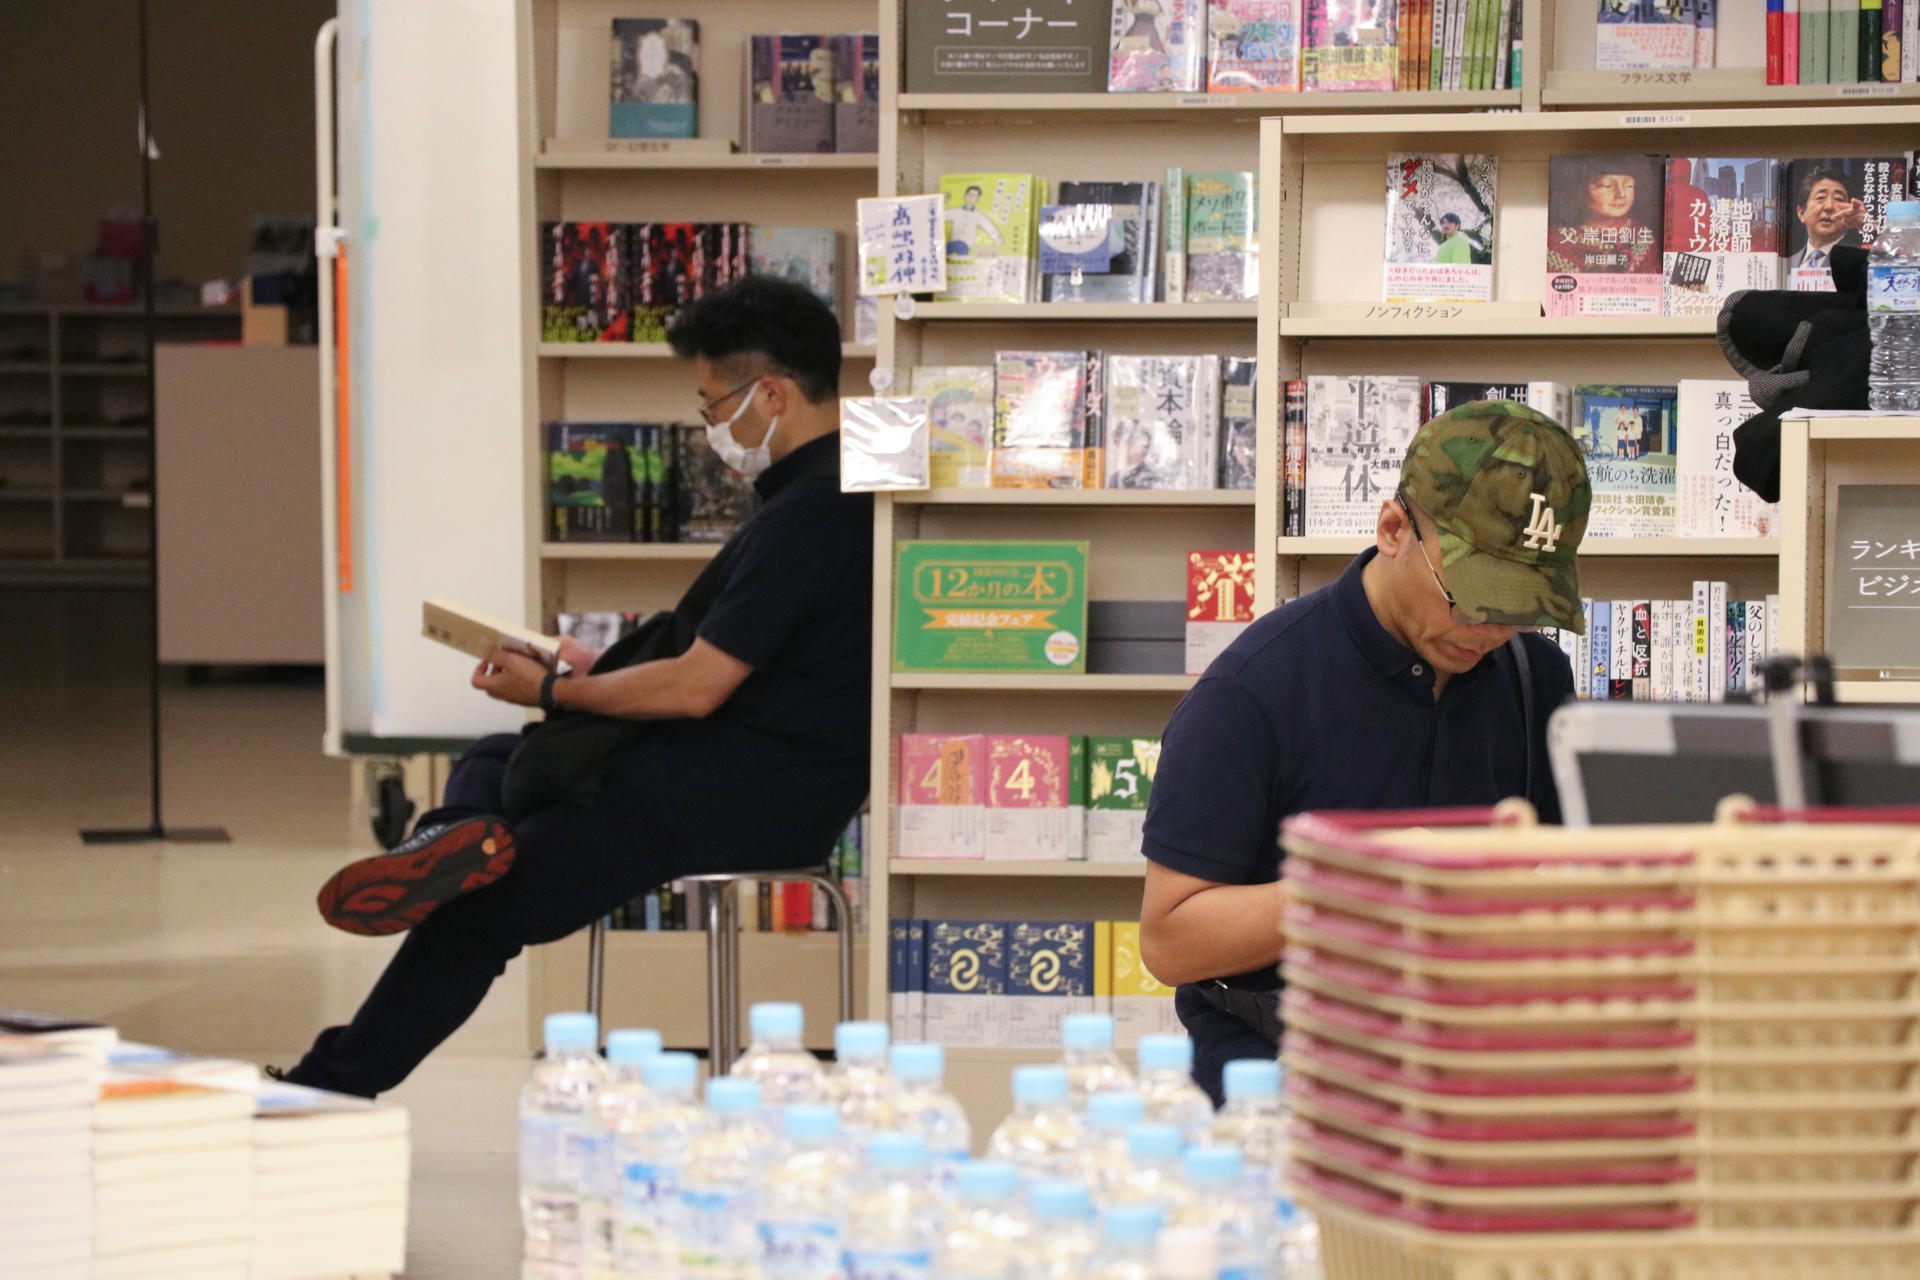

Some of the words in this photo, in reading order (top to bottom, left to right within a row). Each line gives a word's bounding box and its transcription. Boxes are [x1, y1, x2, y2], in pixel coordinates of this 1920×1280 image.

[946, 8, 1078, 39] コーナー
[1620, 72, 1692, 84] フランス文学
[1401, 158, 1422, 253] ダメですか?
[1417, 160, 1435, 255] 施設がそんなに
[1862, 161, 1876, 244] ならなかったのか
[1559, 226, 1577, 245] 父
[1583, 226, 1656, 245] 岸田劉生
[1689, 197, 1708, 253] カトウ
[1709, 197, 1730, 253] 連絡役
[1731, 197, 1752, 253] 地面師
[1585, 253, 1629, 266] 岸田麗子
[1365, 305, 1464, 319] ノンフィクション
[1674, 295, 1724, 305] ノンフィクシ
[1369, 459, 1401, 470] 大鹿靖
[1714, 390, 1734, 532] 真っ白だった！
[1523, 492, 1562, 552] LA
[1851, 539, 1920, 560] ランキ
[929, 565, 1057, 601] 12か月の本
[1634, 607, 1649, 677] 血と反抗
[1005, 759, 1036, 799] 4
[1114, 758, 1139, 799] 5
